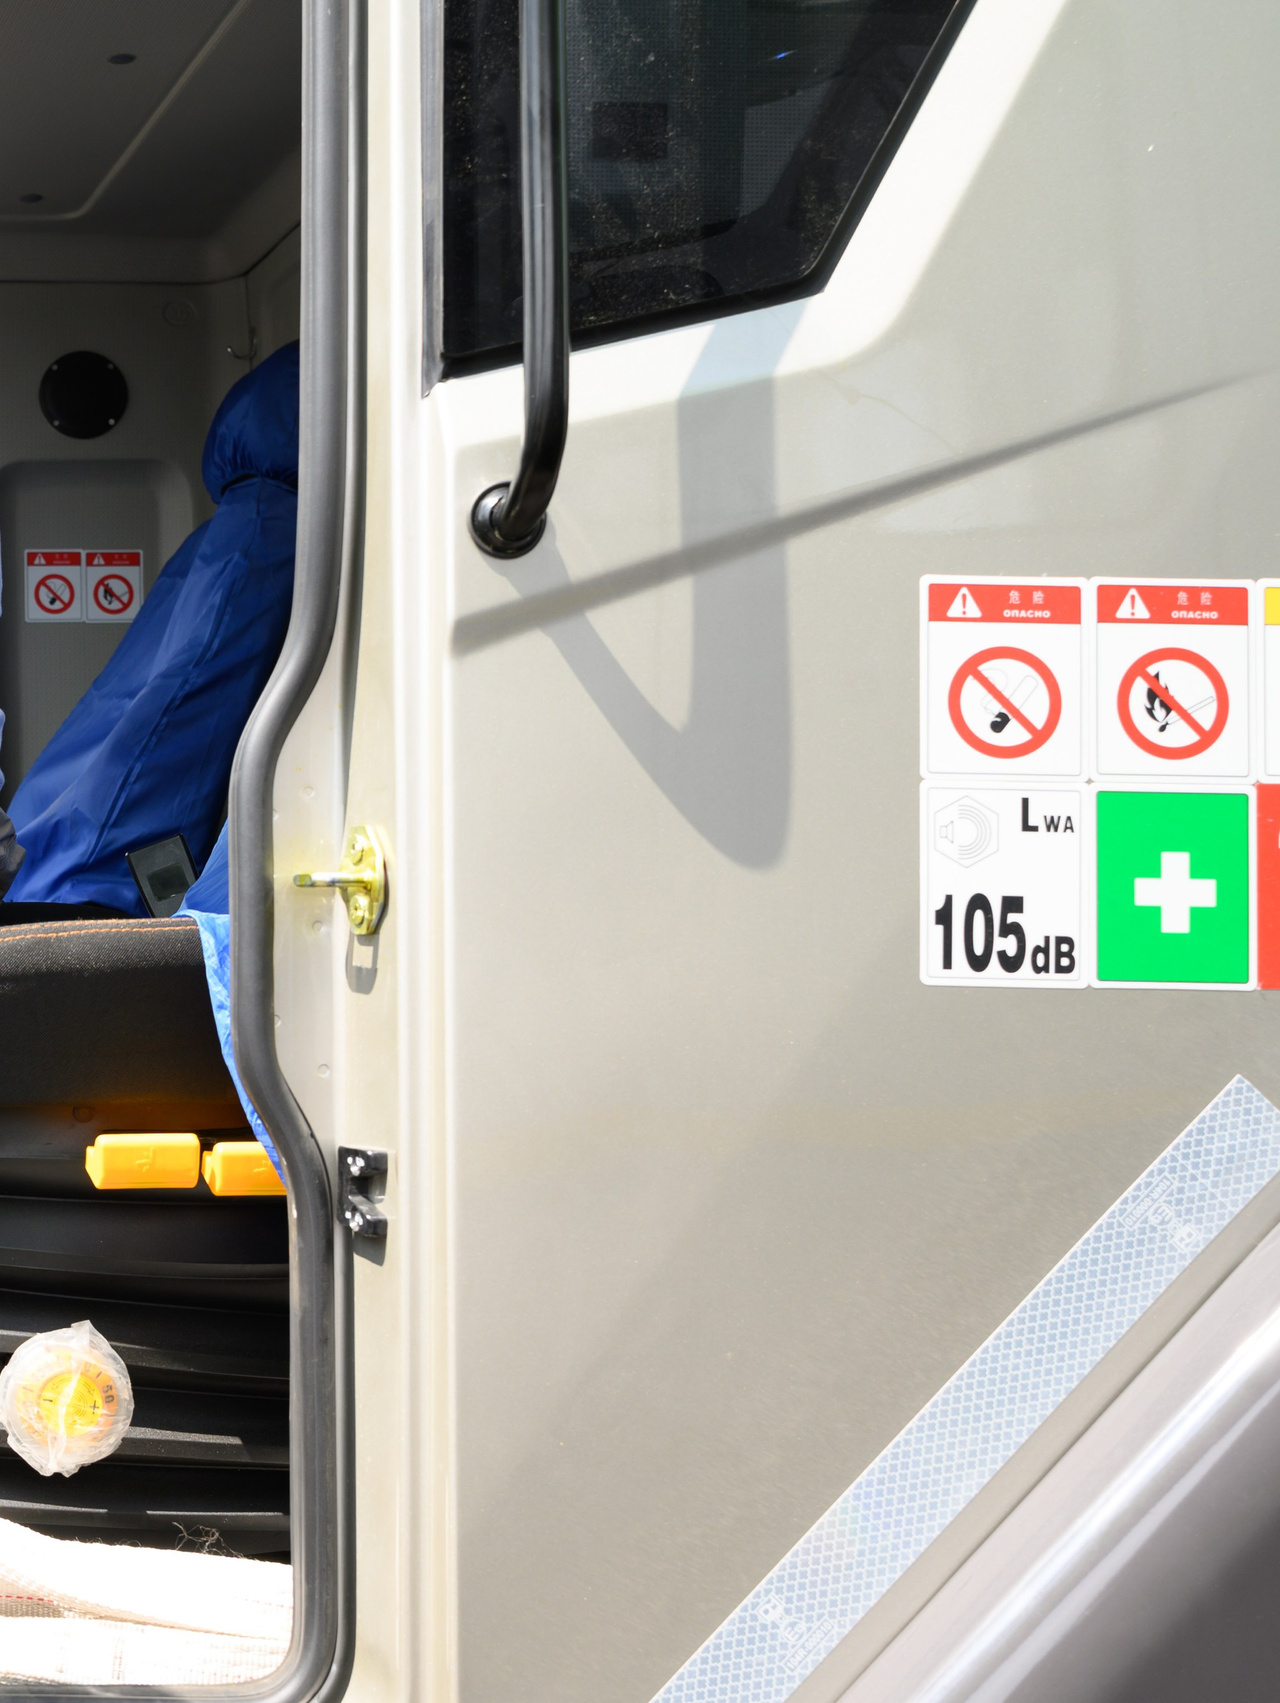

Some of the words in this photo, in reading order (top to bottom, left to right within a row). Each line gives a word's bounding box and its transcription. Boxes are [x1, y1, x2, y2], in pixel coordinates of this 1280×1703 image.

[1008, 589, 1045, 606] 危险
[1176, 590, 1213, 607] 危险
[1003, 609, 1052, 619] ОПАСНО
[1171, 610, 1219, 620] ОПАСНО
